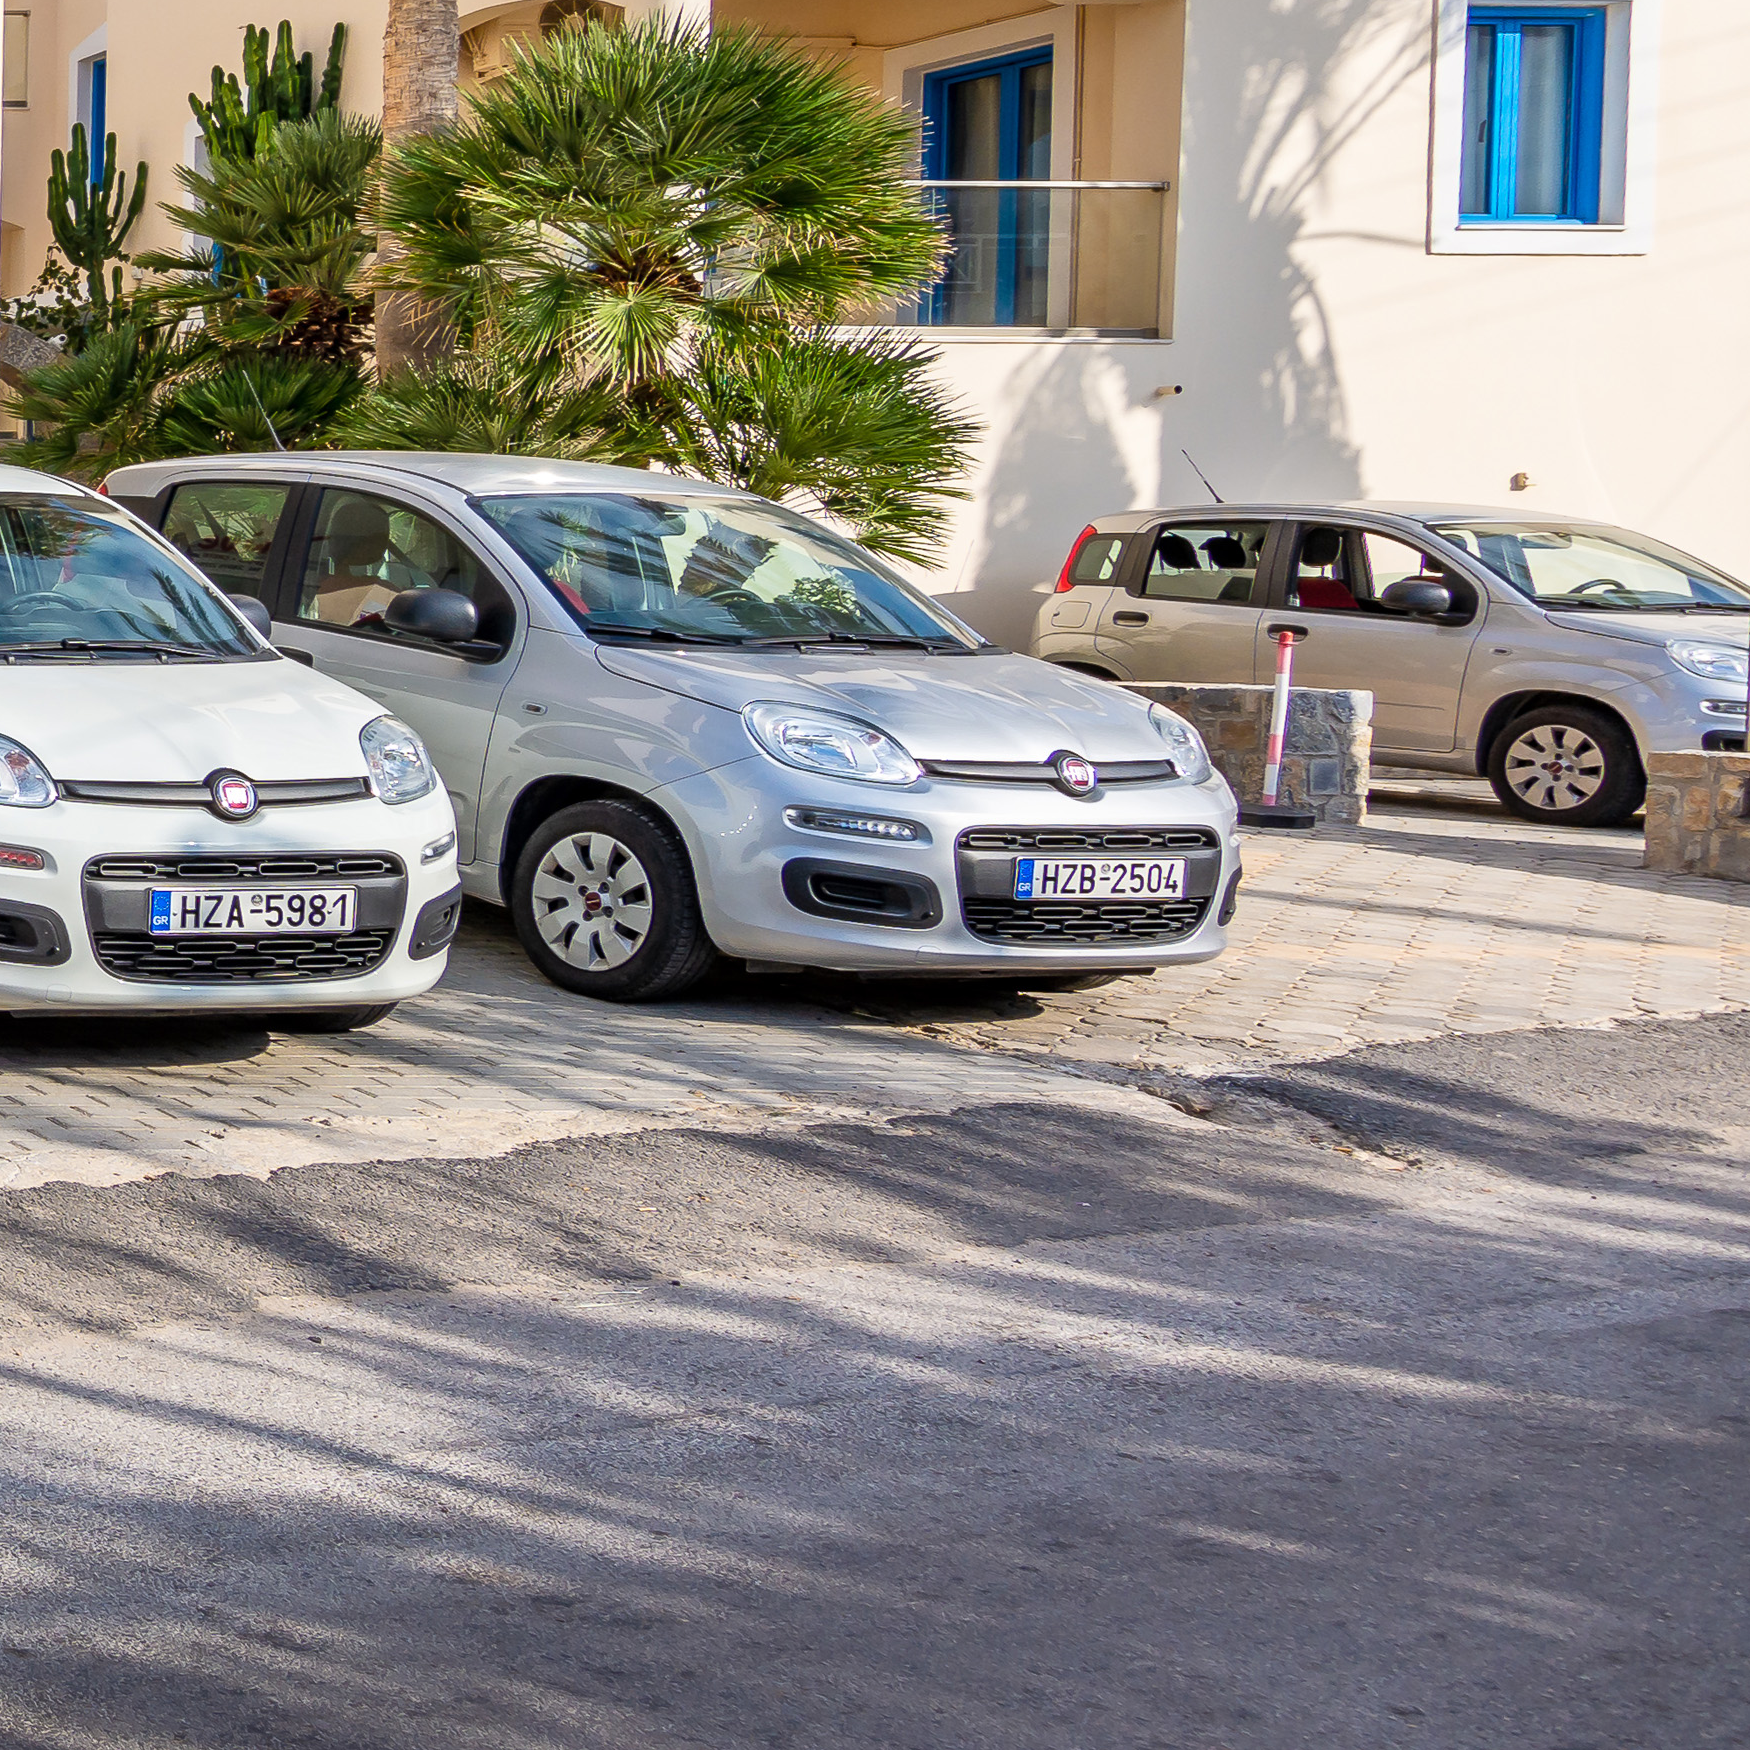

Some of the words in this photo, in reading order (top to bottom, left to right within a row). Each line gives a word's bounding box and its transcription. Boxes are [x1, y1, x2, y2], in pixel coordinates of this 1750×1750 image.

[1017, 882, 1032, 893] GR
[1040, 862, 1179, 896] HZB-2504
[153, 915, 169, 926] GR
[179, 893, 348, 929] HZA-5981
